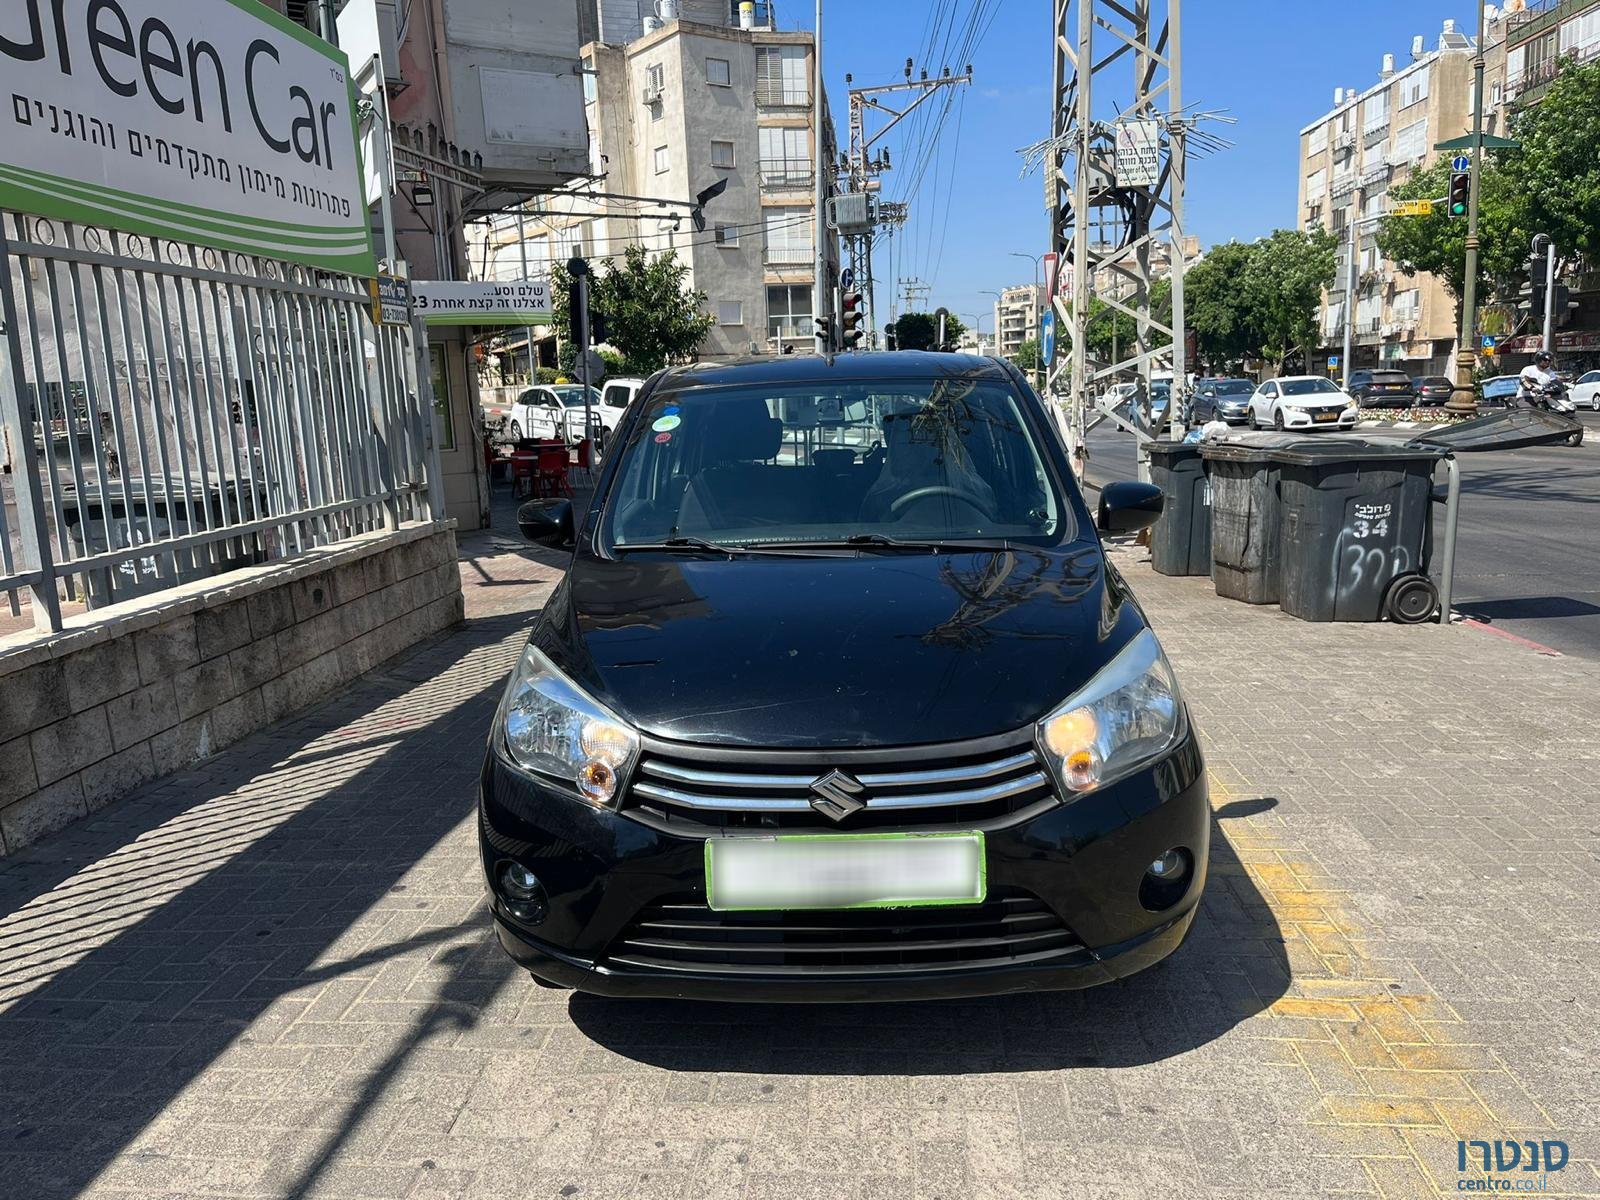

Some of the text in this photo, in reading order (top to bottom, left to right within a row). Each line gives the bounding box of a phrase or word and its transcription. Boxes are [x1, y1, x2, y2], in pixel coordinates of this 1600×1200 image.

[244, 38, 336, 171] Car
[11, 93, 351, 218] פתרונות מימון מתקדמים והוגנים
[518, 284, 544, 297] שלם
[411, 295, 428, 309] 23
[432, 297, 545, 311] אצלנו זה קצת אחרת
[1353, 520, 1388, 537] 34
